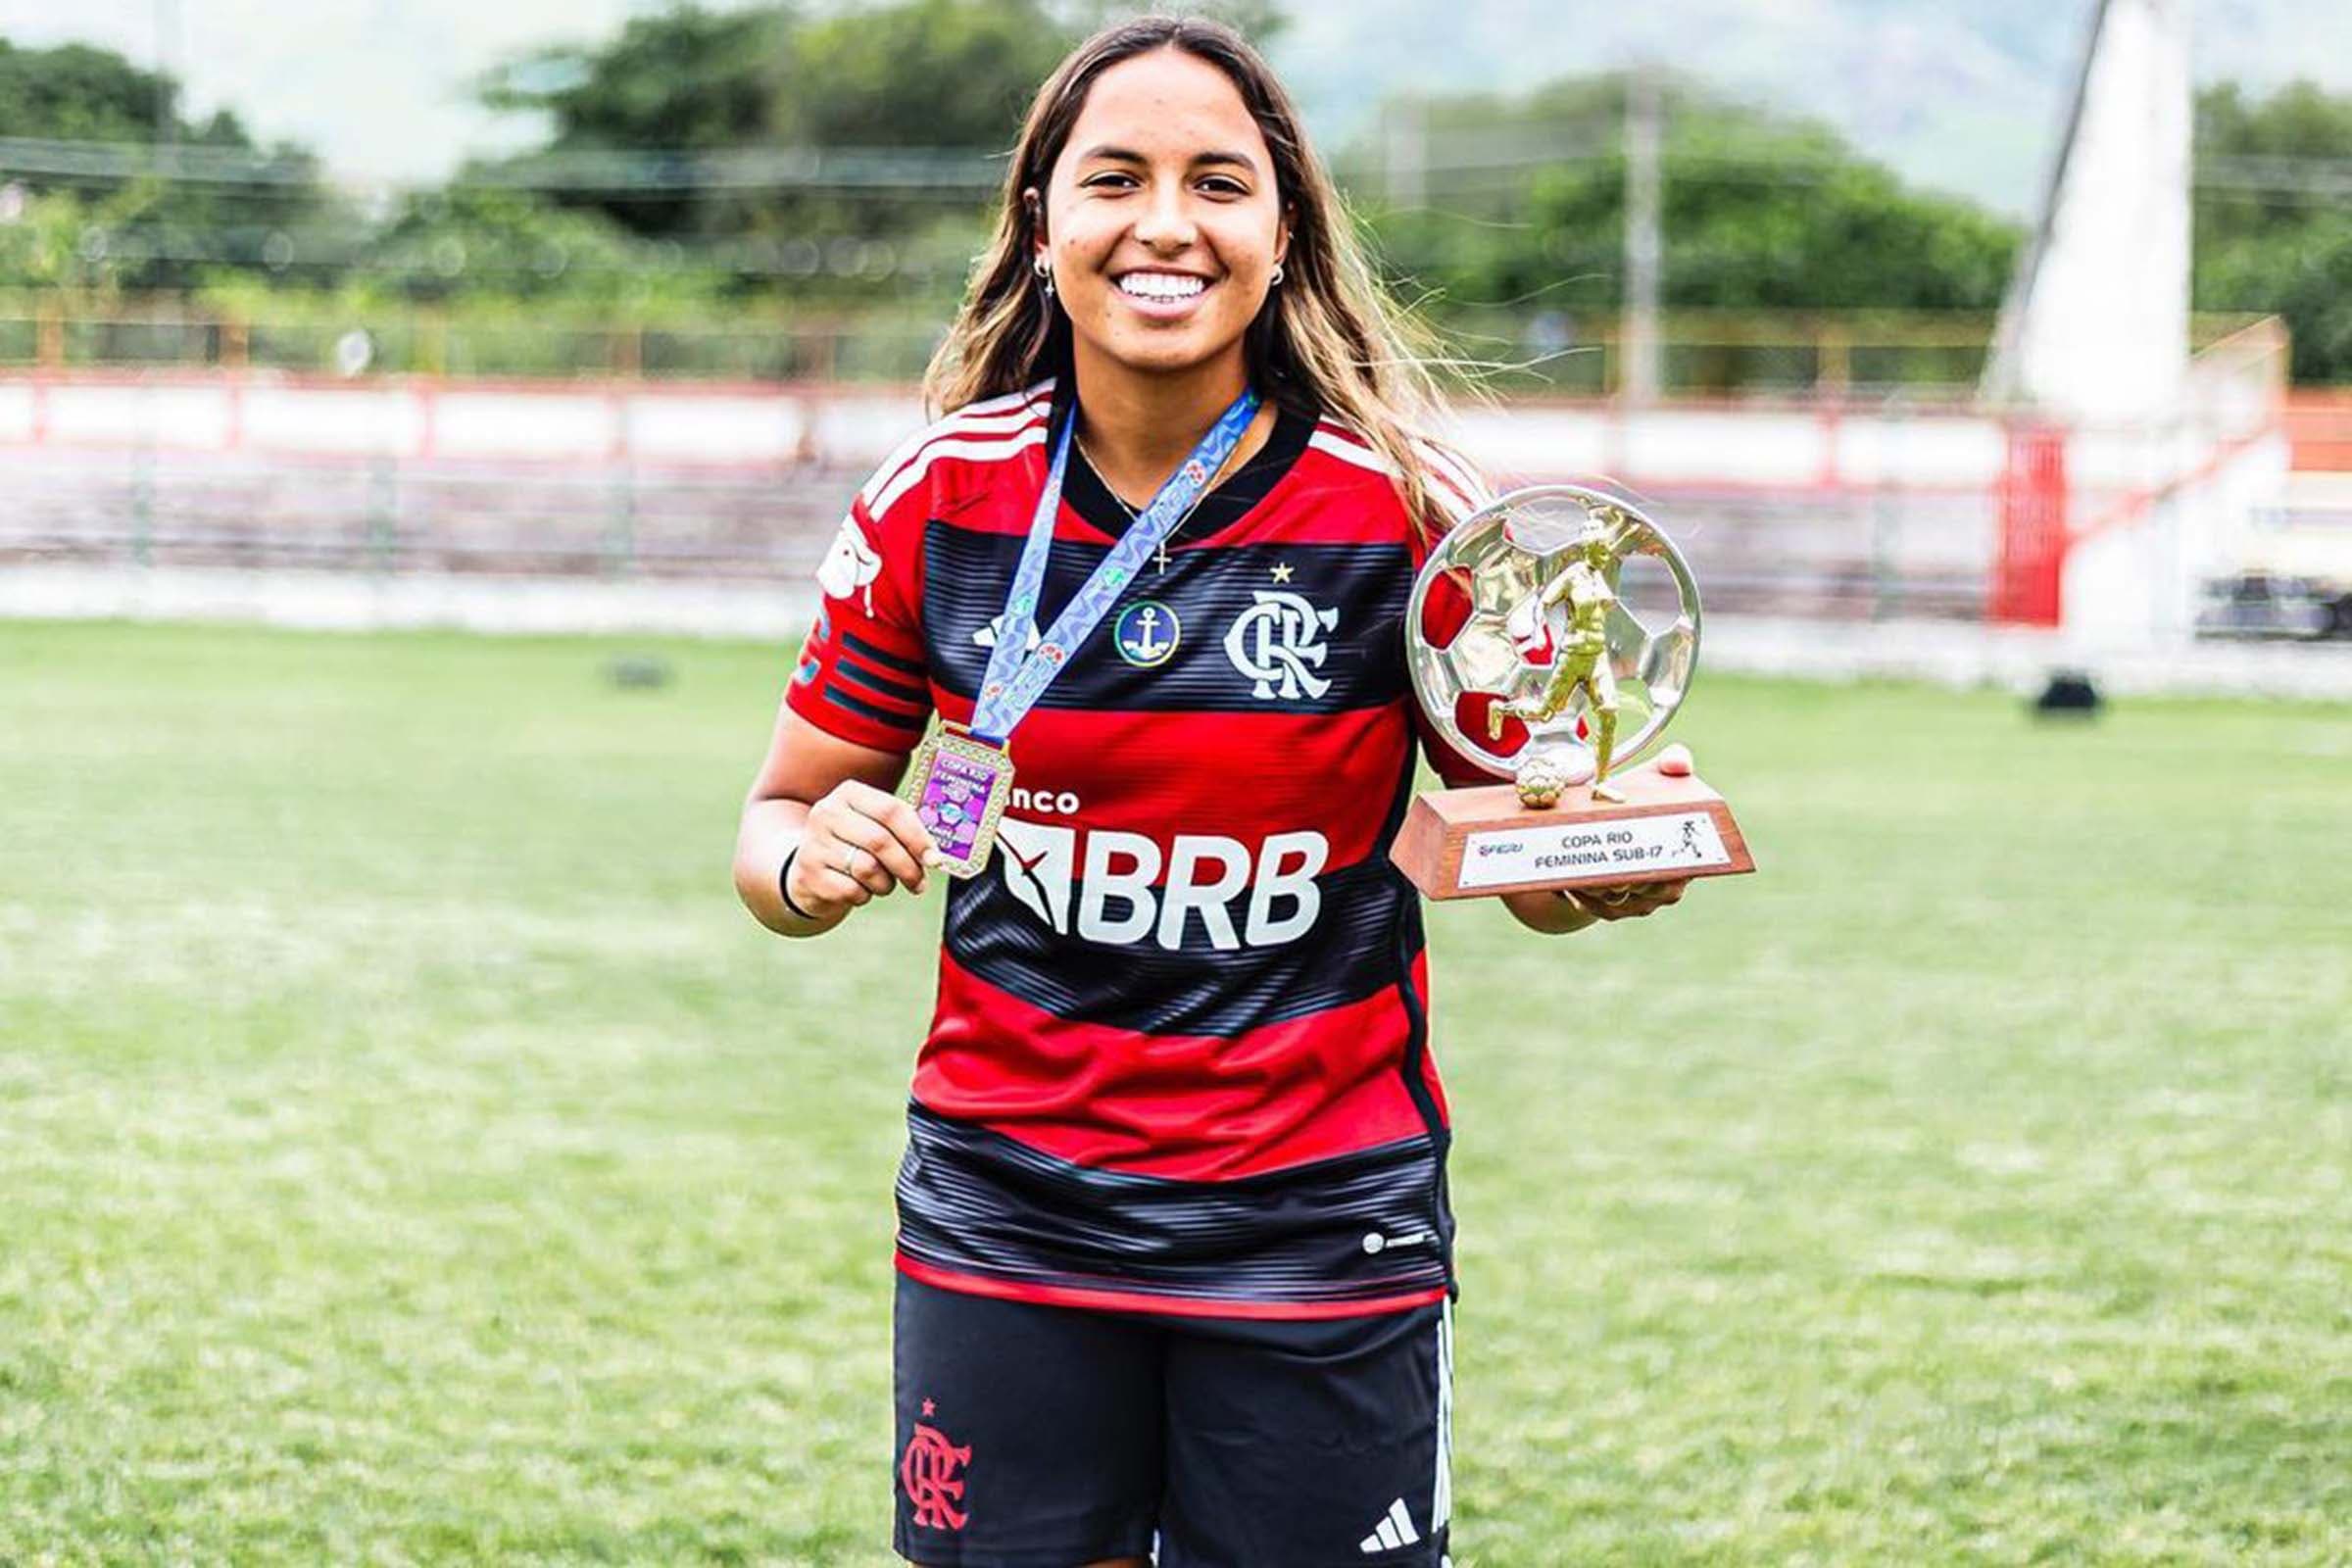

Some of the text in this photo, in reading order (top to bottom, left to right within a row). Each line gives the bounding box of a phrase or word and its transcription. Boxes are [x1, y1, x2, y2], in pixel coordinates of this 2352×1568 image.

[1005, 788, 1080, 814] nco
[1562, 831, 1633, 849] COPA RIO
[1535, 846, 1663, 868] FEMININA SUB-17
[1078, 830, 1329, 951] BRB
